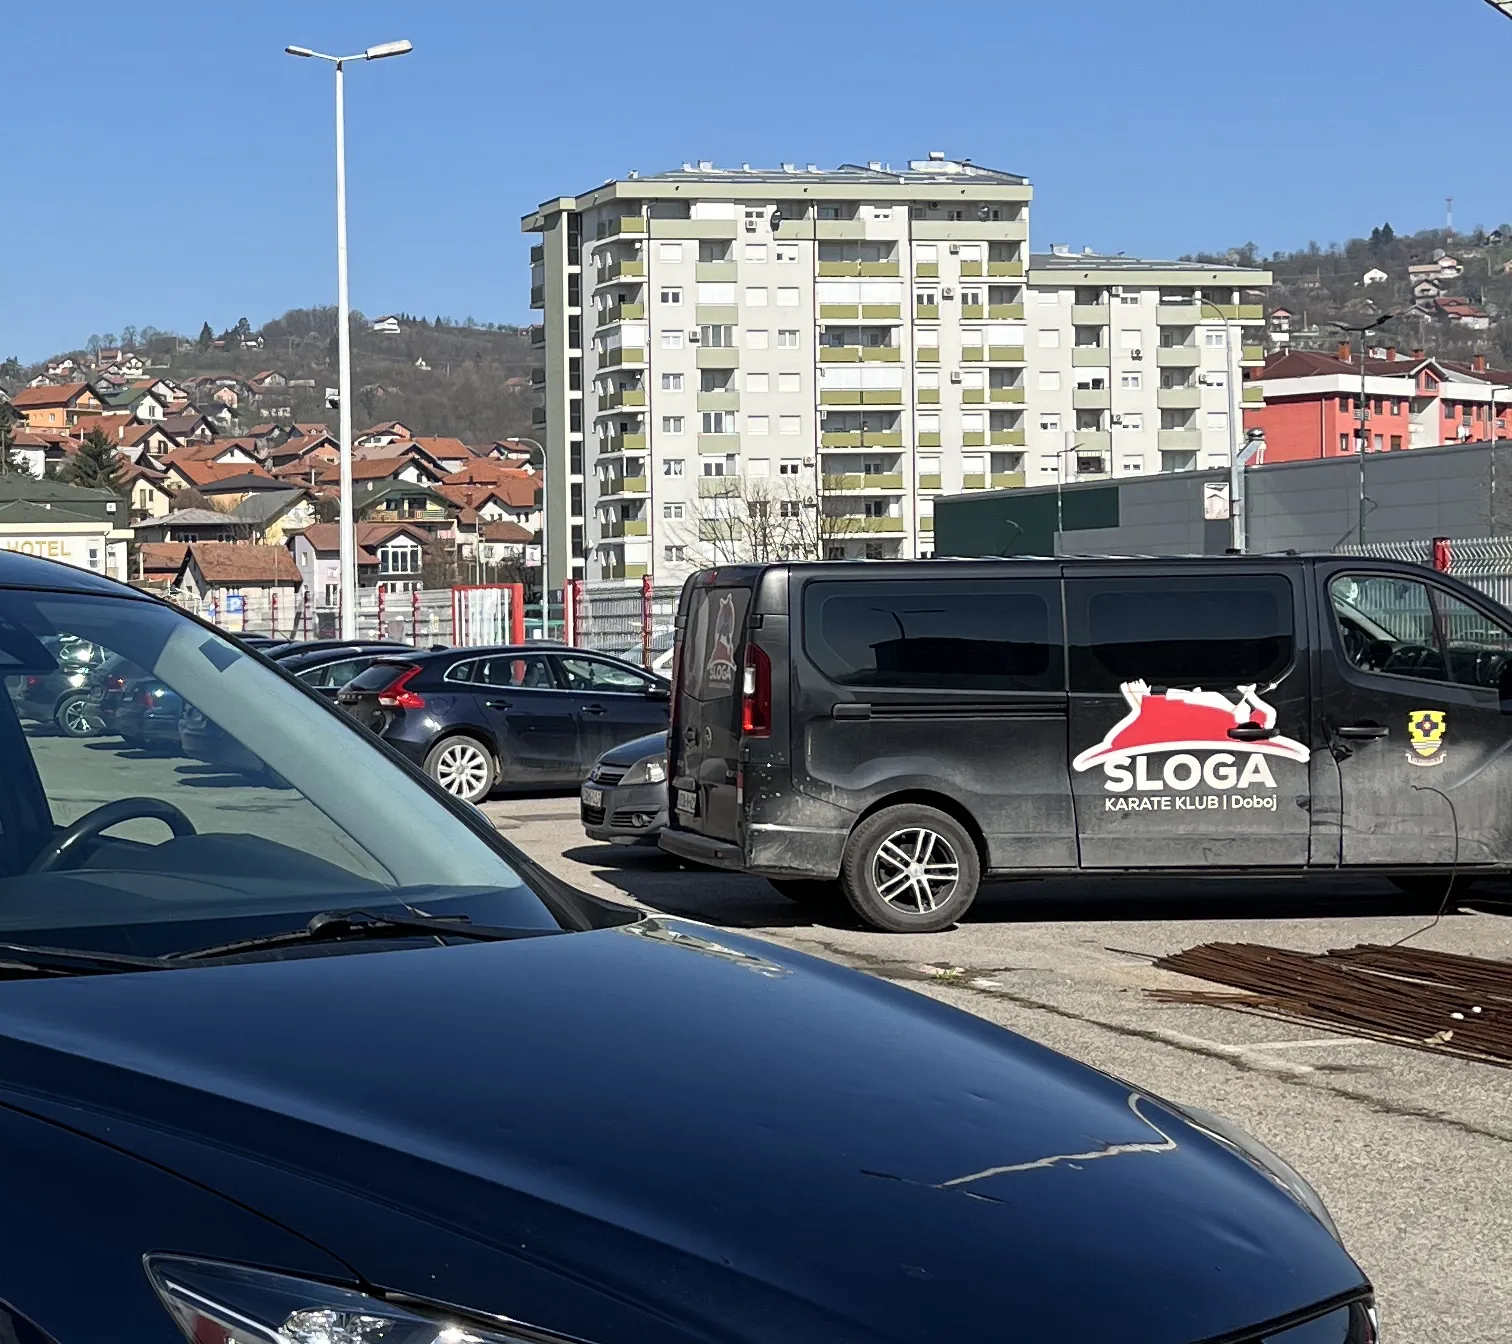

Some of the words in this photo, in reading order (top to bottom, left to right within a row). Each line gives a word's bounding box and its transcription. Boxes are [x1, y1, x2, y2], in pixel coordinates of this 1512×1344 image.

[7, 540, 71, 557] HOTEL
[1104, 753, 1277, 792] SLOGA
[1105, 796, 1172, 811] KARATE
[1175, 795, 1219, 810] KLUB
[1231, 794, 1277, 812] Doboj
